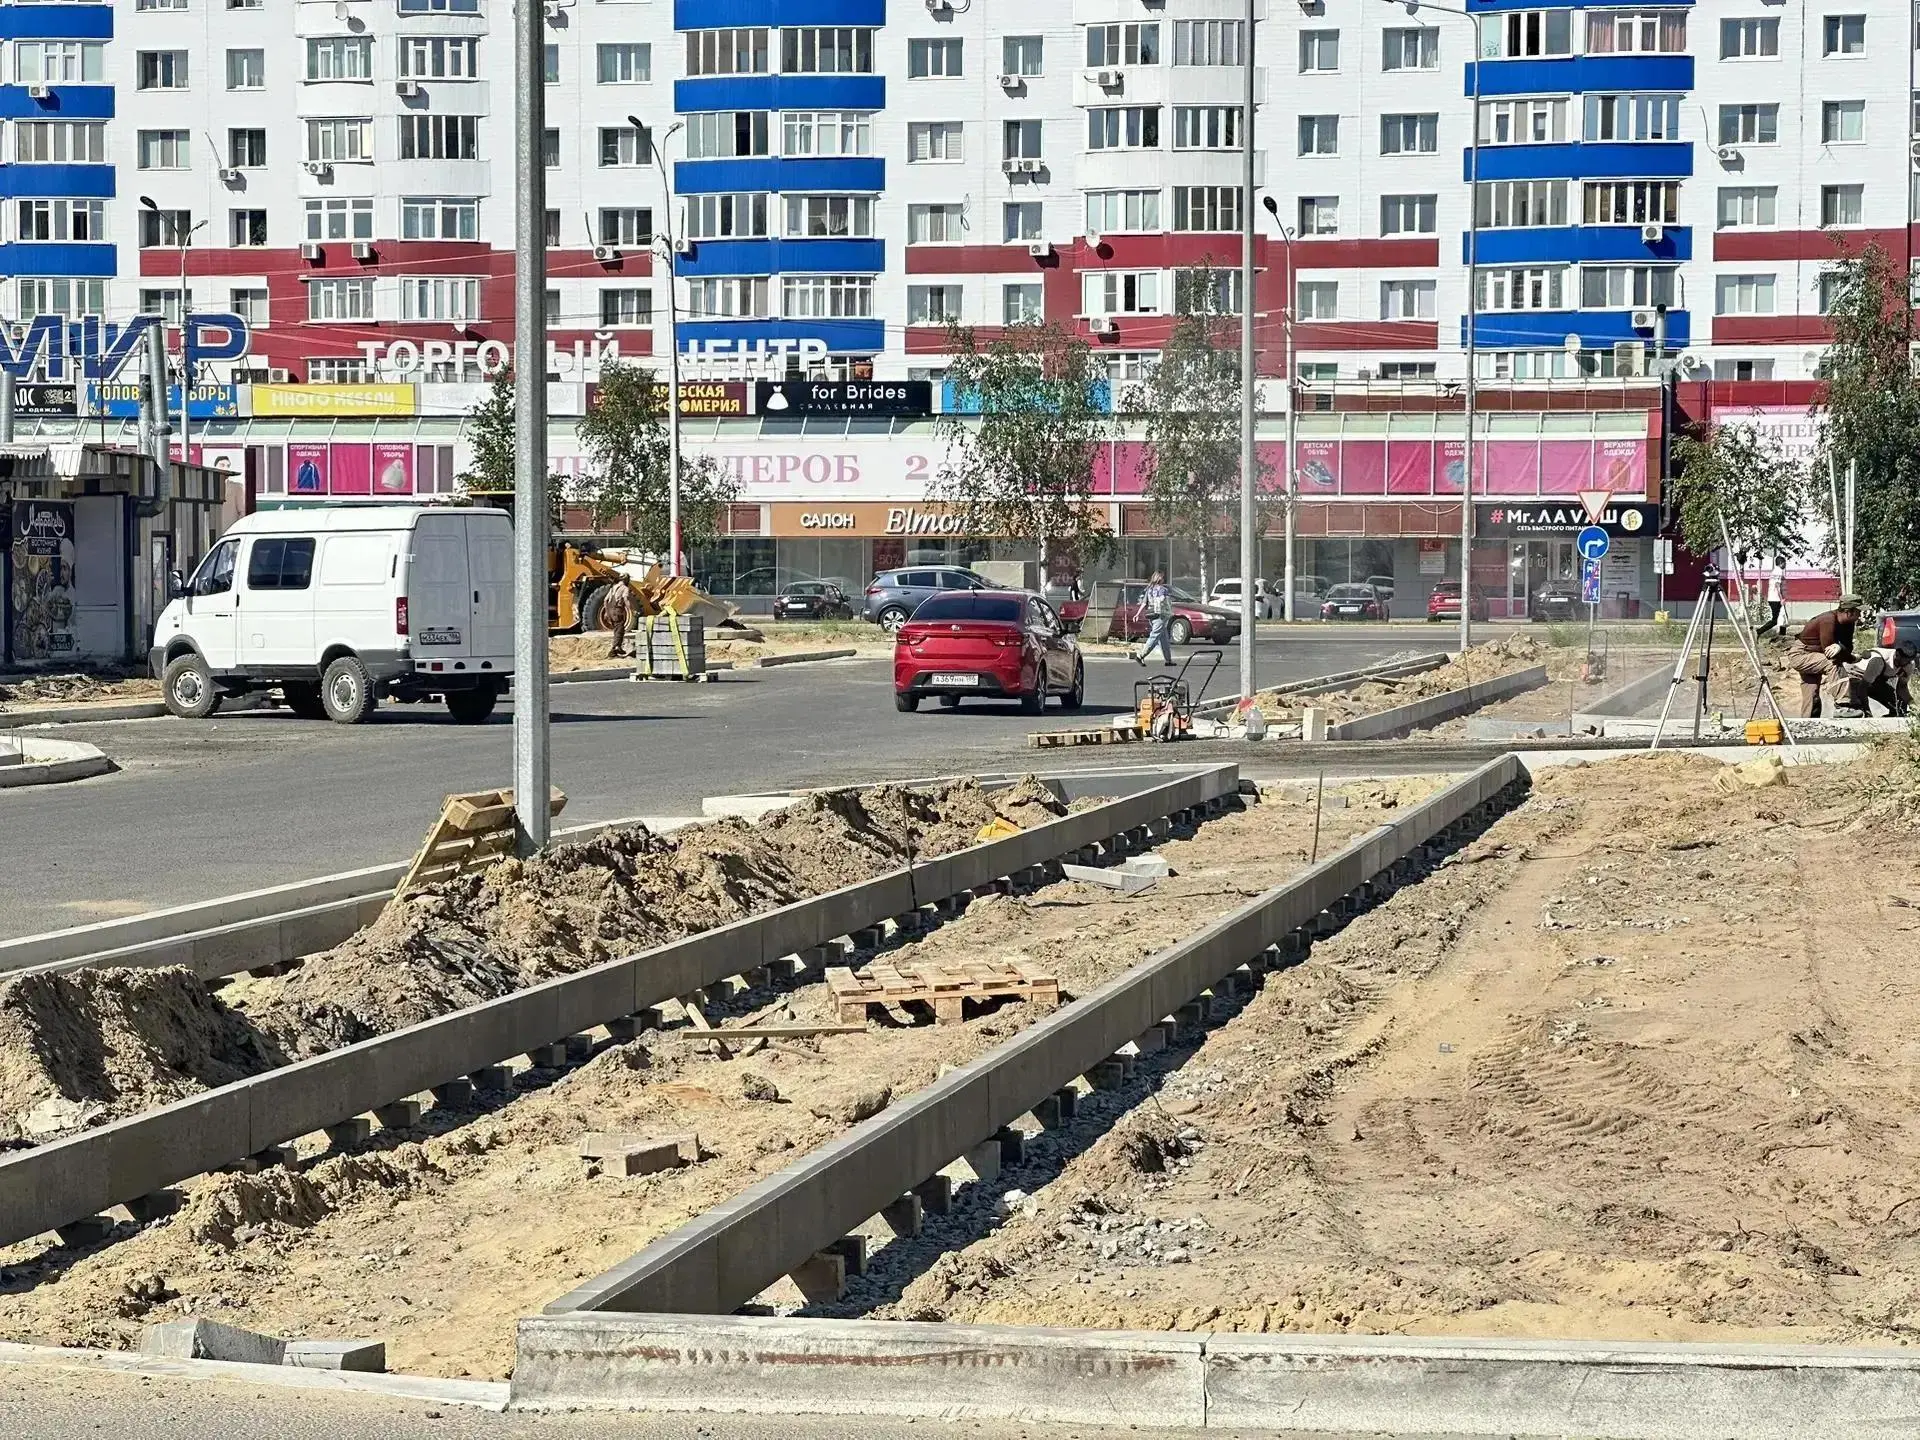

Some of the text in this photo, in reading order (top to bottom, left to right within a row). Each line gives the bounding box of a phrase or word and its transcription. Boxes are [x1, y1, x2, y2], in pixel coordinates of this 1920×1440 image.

[0, 312, 249, 384] МИР
[357, 331, 620, 375] ТОРГОЫЙ
[94, 386, 231, 401] ГОЛОВЕ БОРЫ
[651, 385, 725, 398] АРБСКАЯ
[811, 385, 907, 399] for Brides
[169, 447, 195, 456] ОБУЬ
[904, 455, 930, 481] 2
[799, 512, 856, 529] САЛОН
